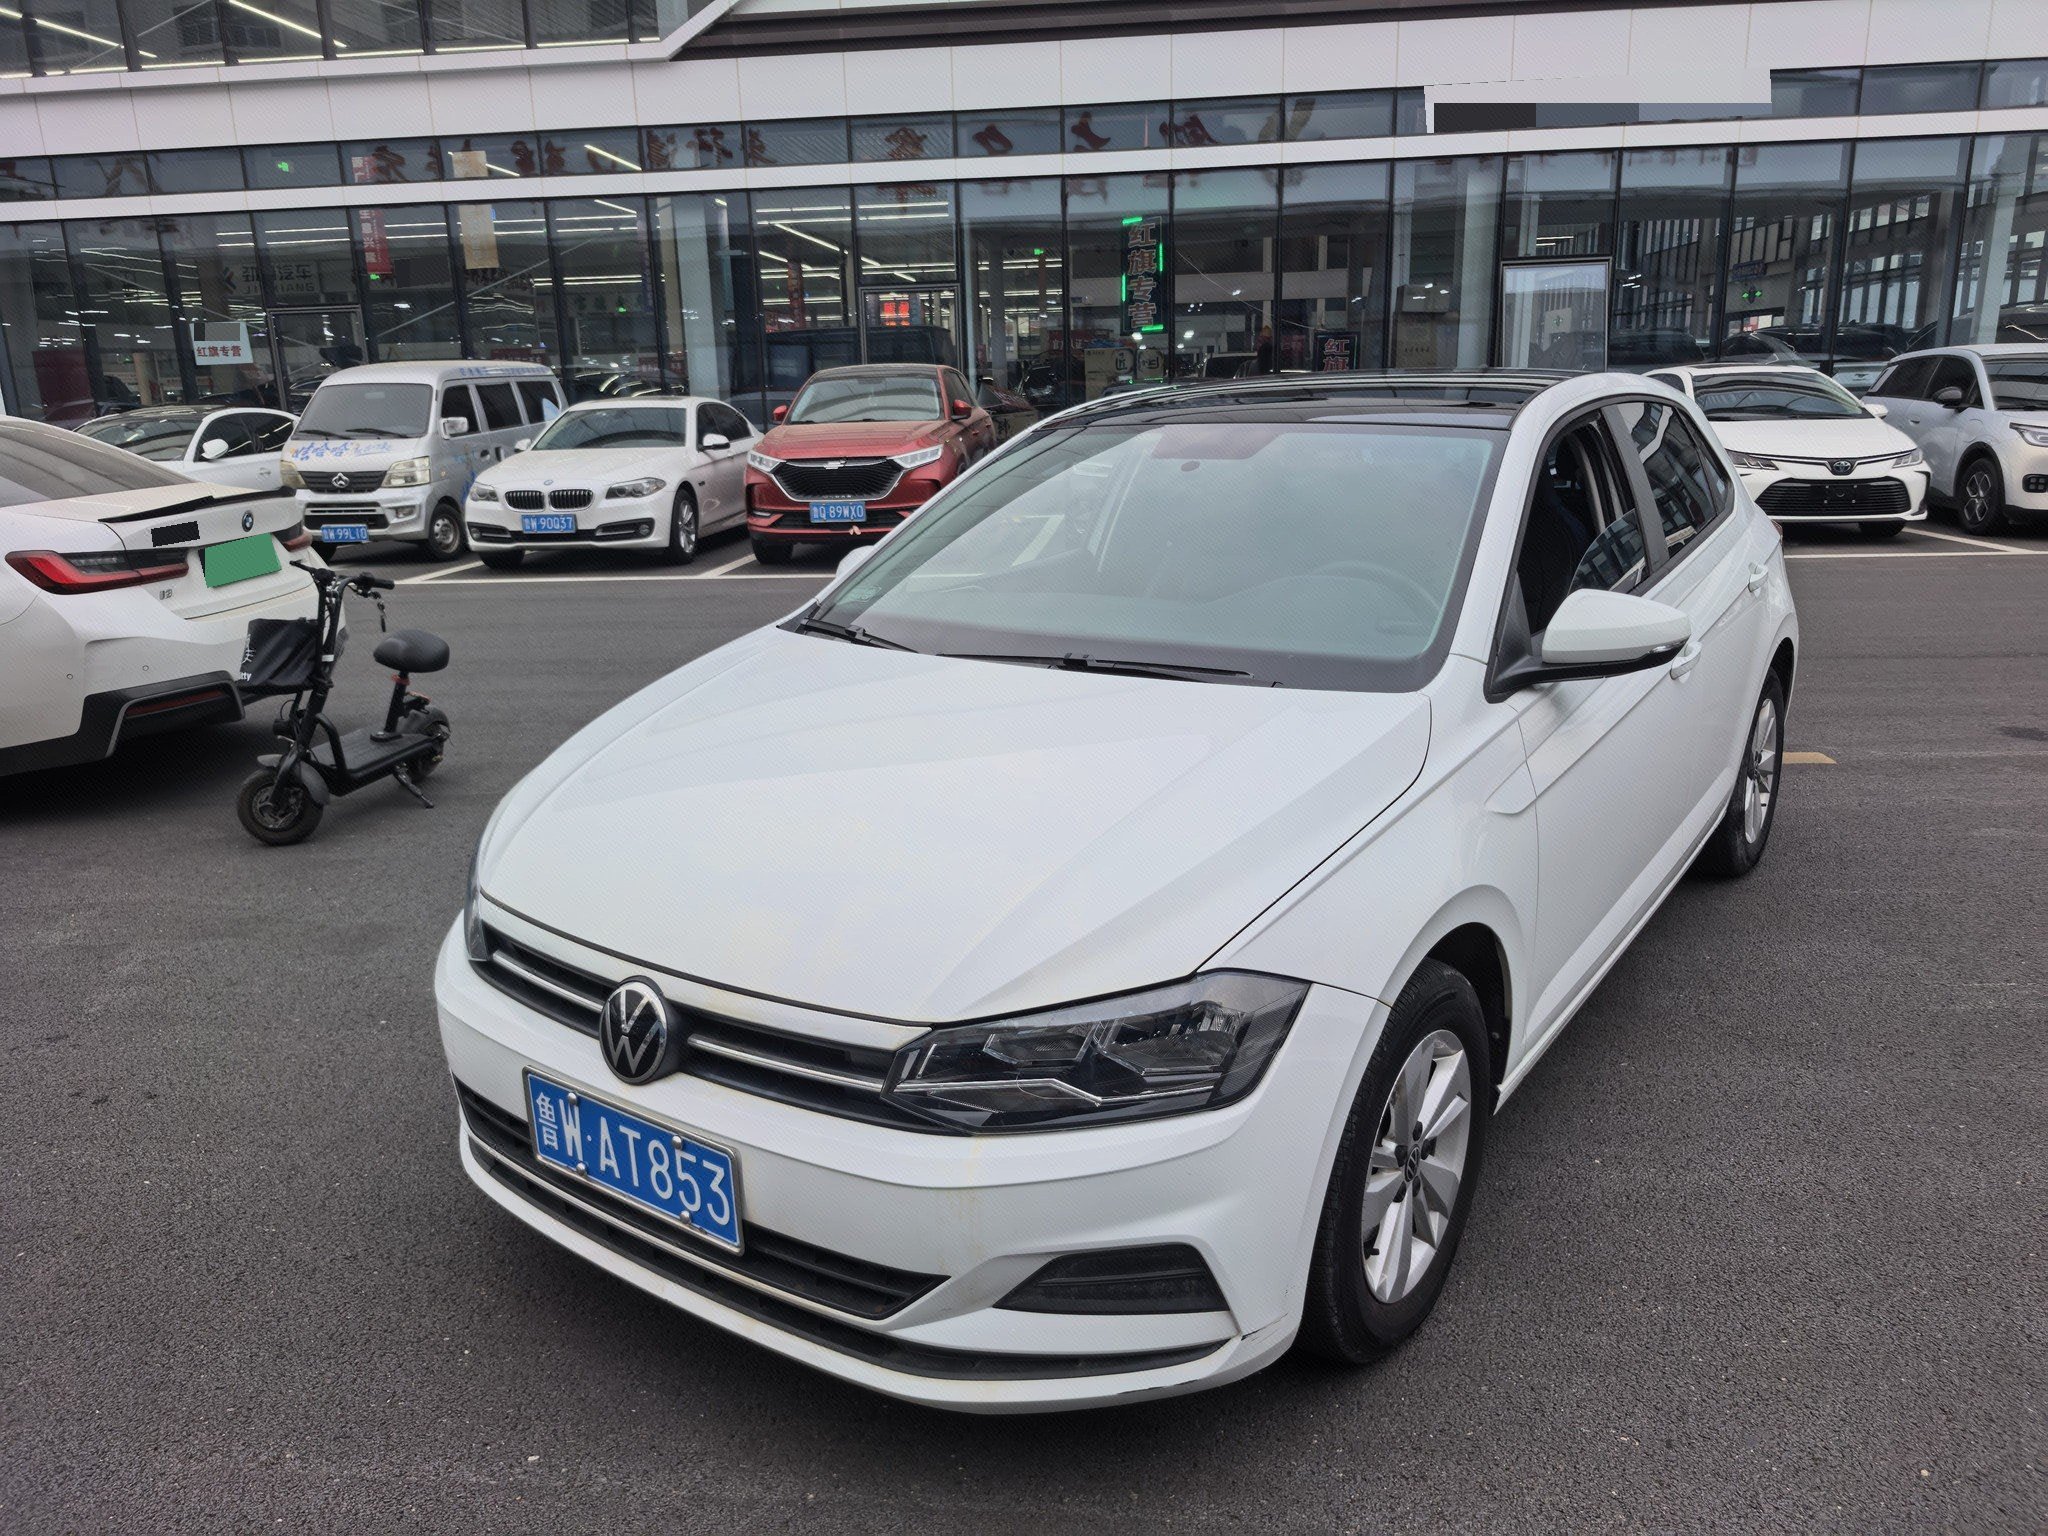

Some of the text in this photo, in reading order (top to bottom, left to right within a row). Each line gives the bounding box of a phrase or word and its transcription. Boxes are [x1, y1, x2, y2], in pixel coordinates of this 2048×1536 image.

[1127, 222, 1157, 328] 红旗专营
[197, 345, 241, 357] 红旗专营
